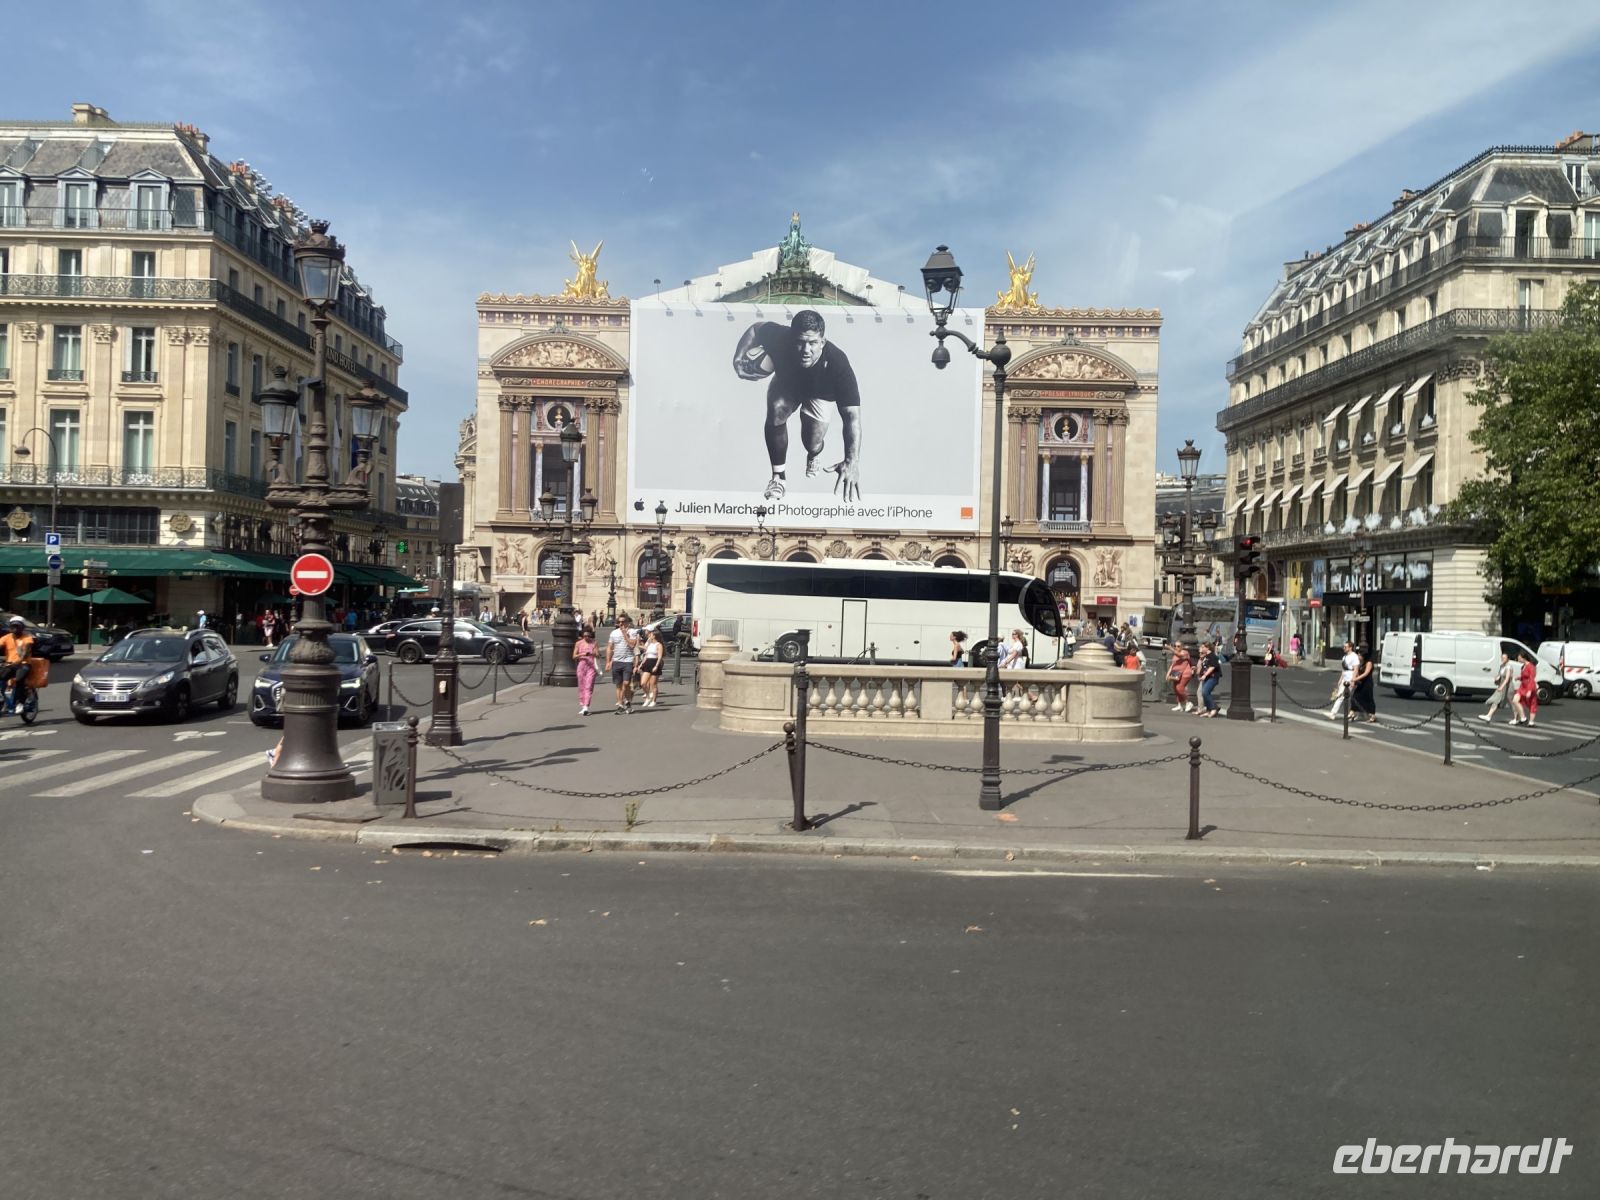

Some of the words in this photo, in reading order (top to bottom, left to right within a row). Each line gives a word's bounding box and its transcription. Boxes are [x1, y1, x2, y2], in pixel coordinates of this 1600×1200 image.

[675, 501, 711, 514] Julien
[778, 504, 855, 518] Photographié
[857, 507, 885, 518] avec
[887, 505, 933, 518] l'iPhone
